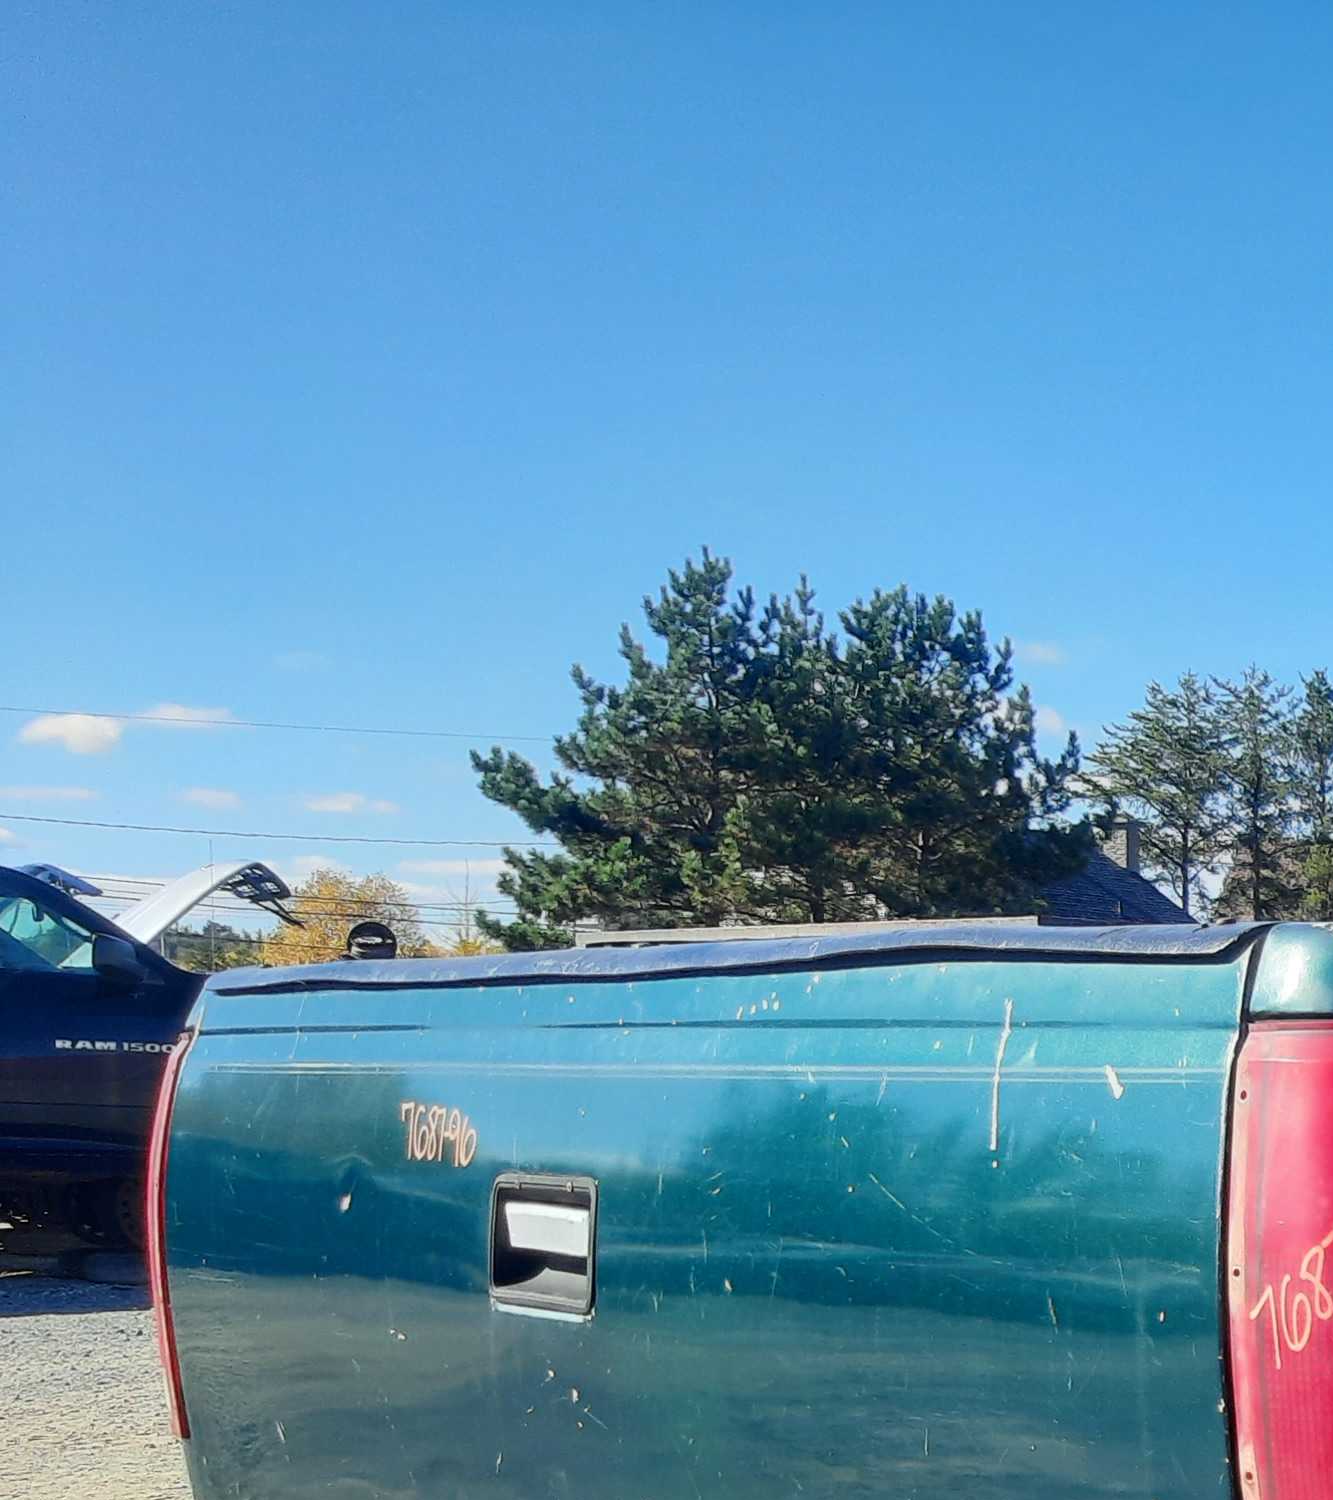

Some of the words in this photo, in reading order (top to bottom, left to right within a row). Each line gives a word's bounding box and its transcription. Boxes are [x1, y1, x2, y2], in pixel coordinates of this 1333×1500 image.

[54, 1039, 117, 1051] RAM
[122, 1041, 177, 1054] 1500
[401, 1101, 477, 1168] 7687-96
